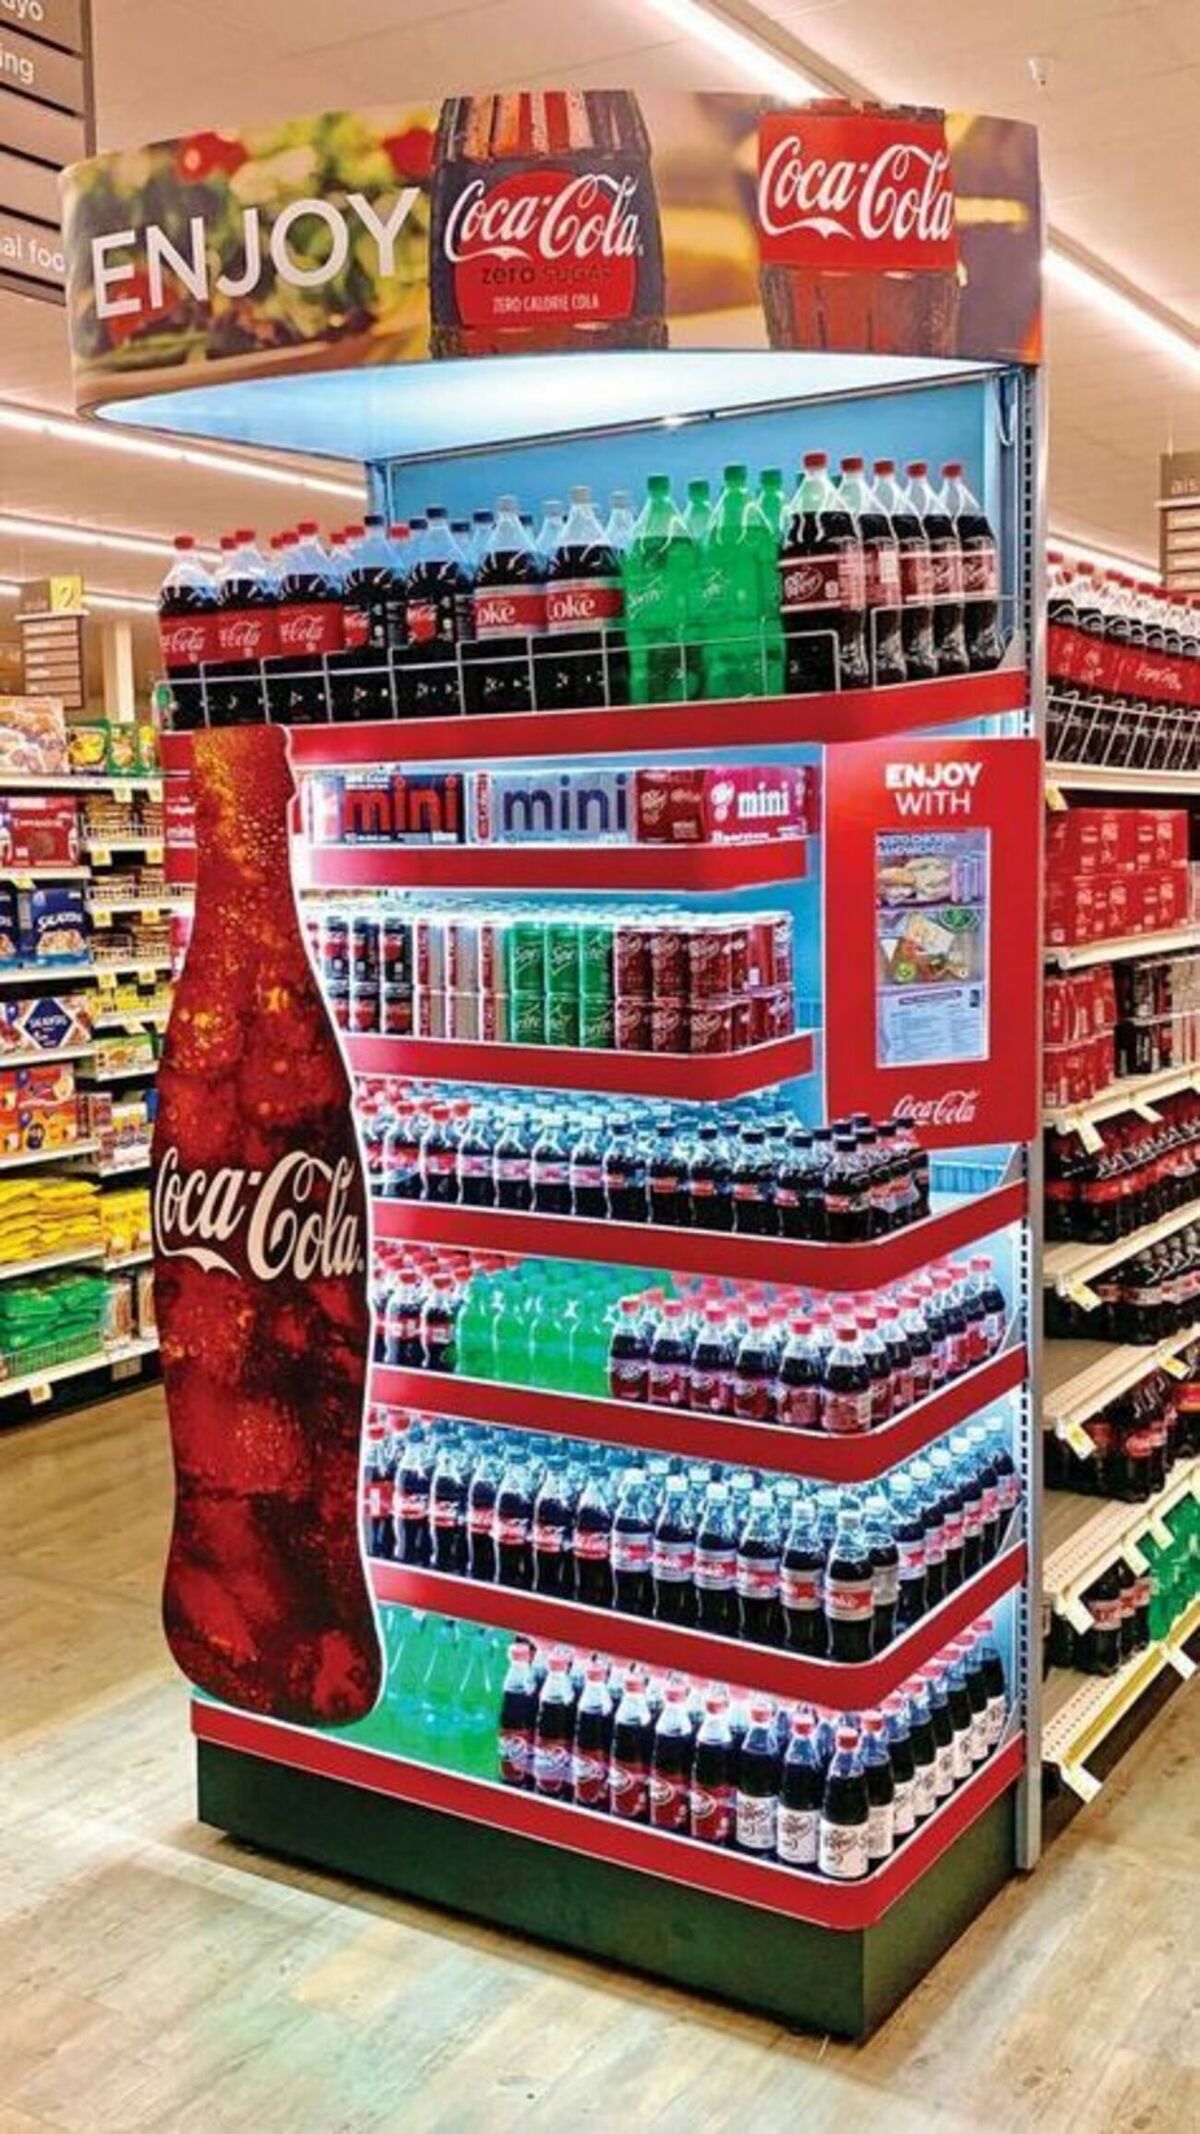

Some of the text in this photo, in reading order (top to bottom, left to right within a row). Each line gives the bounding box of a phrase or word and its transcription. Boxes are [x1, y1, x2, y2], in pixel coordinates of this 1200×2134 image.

[758, 135, 953, 241] Coca-Cola
[444, 173, 642, 263] Coca-Cola
[91, 187, 420, 319] ENJOY
[493, 296, 522, 314] ZERO
[344, 775, 457, 832] mini
[503, 773, 626, 831] mini
[737, 781, 789, 819] mini
[885, 761, 982, 789] ENJOY
[894, 789, 971, 815] WITH
[892, 1090, 980, 1125] Coca-Cola
[154, 1146, 364, 1281] Coca-Cola
